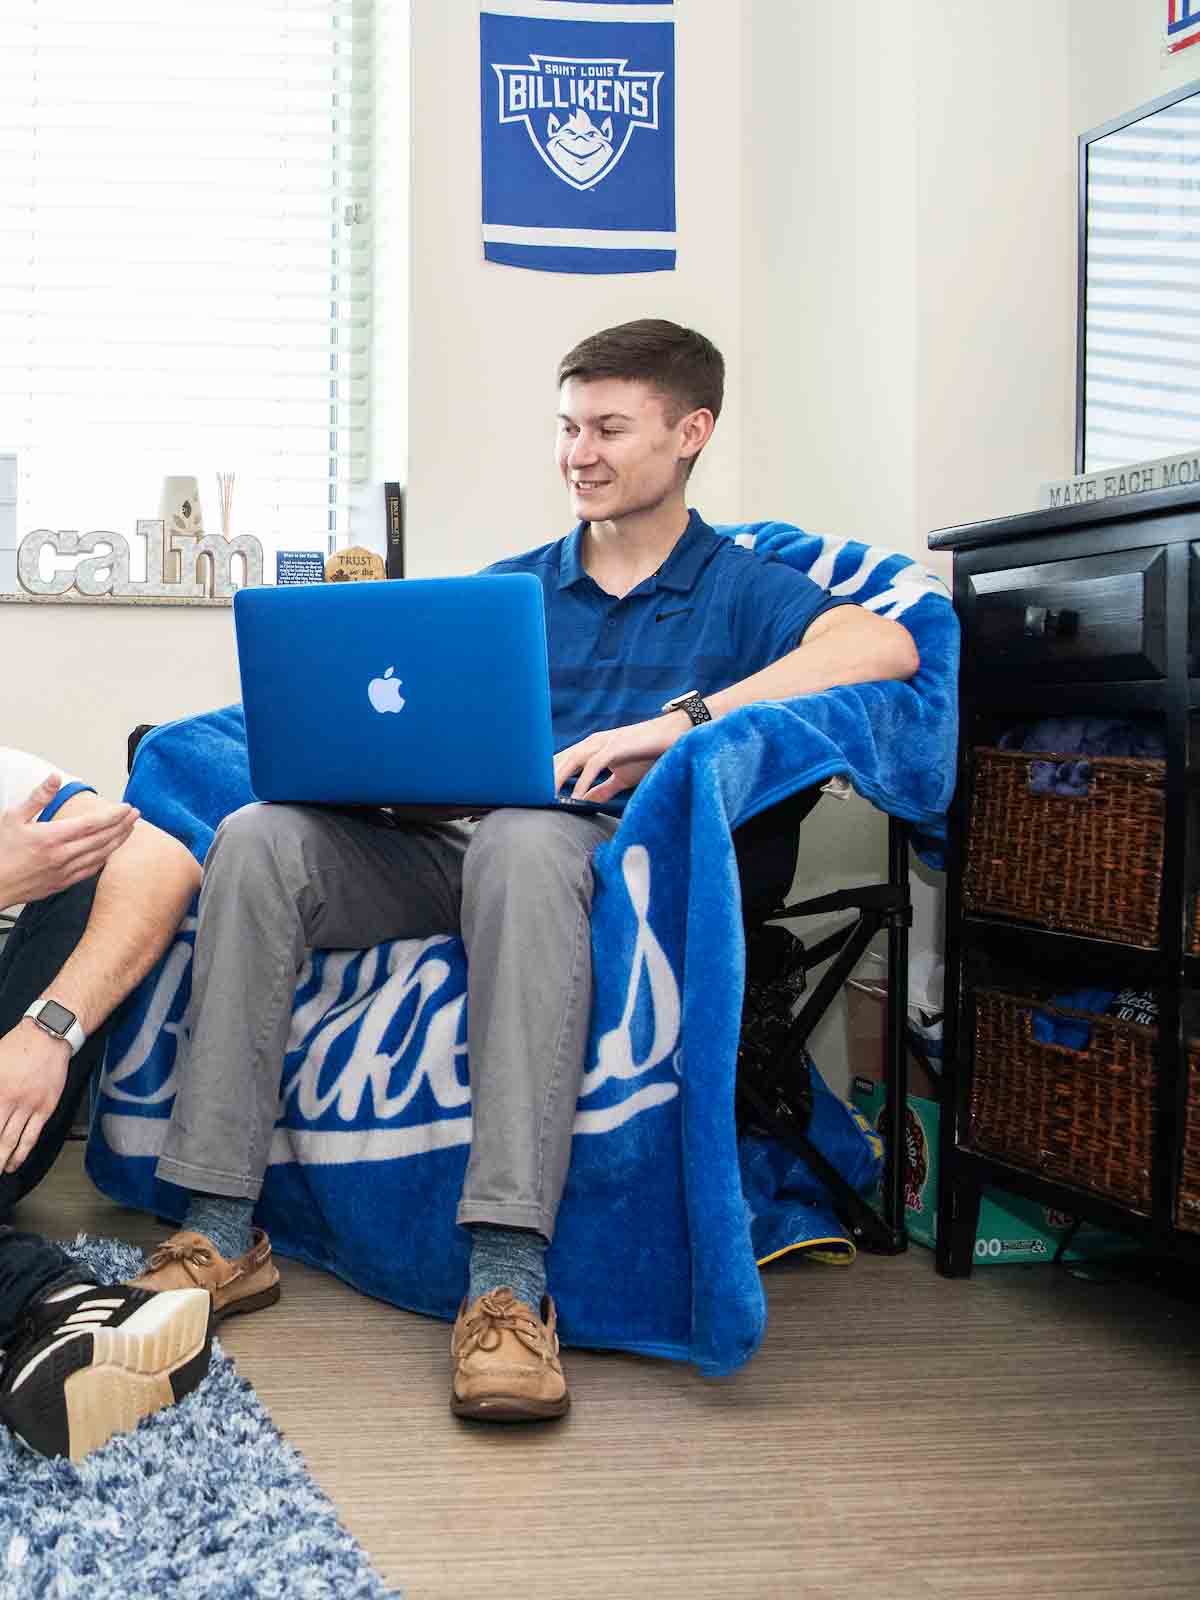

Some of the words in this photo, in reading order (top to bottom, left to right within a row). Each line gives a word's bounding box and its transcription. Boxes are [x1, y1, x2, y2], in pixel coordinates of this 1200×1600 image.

[544, 63, 577, 77] SAINT
[580, 65, 615, 78] LOUIS
[509, 74, 649, 117] BILLIKENS
[1049, 480, 1097, 507] MAKE
[1103, 468, 1155, 497] EACH
[17, 519, 264, 598] calm
[336, 555, 374, 567] TRUST
